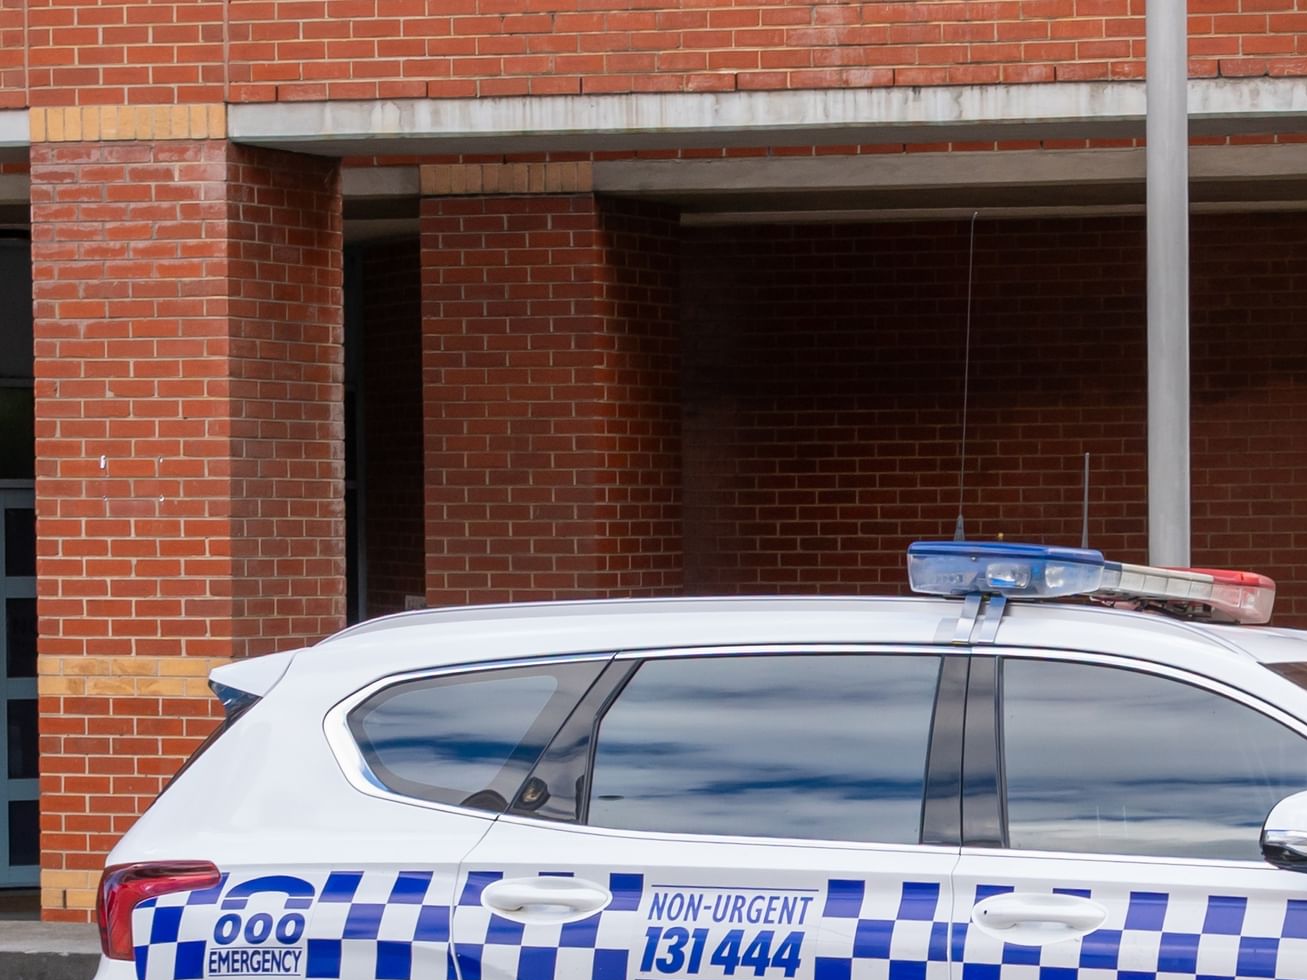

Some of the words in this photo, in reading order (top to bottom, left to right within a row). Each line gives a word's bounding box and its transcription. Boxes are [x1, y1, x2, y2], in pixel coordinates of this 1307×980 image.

[648, 892, 814, 925] NON-URGENT
[208, 949, 302, 973] EMERGENCY
[640, 926, 710, 975] 131
[710, 929, 806, 978] 444
